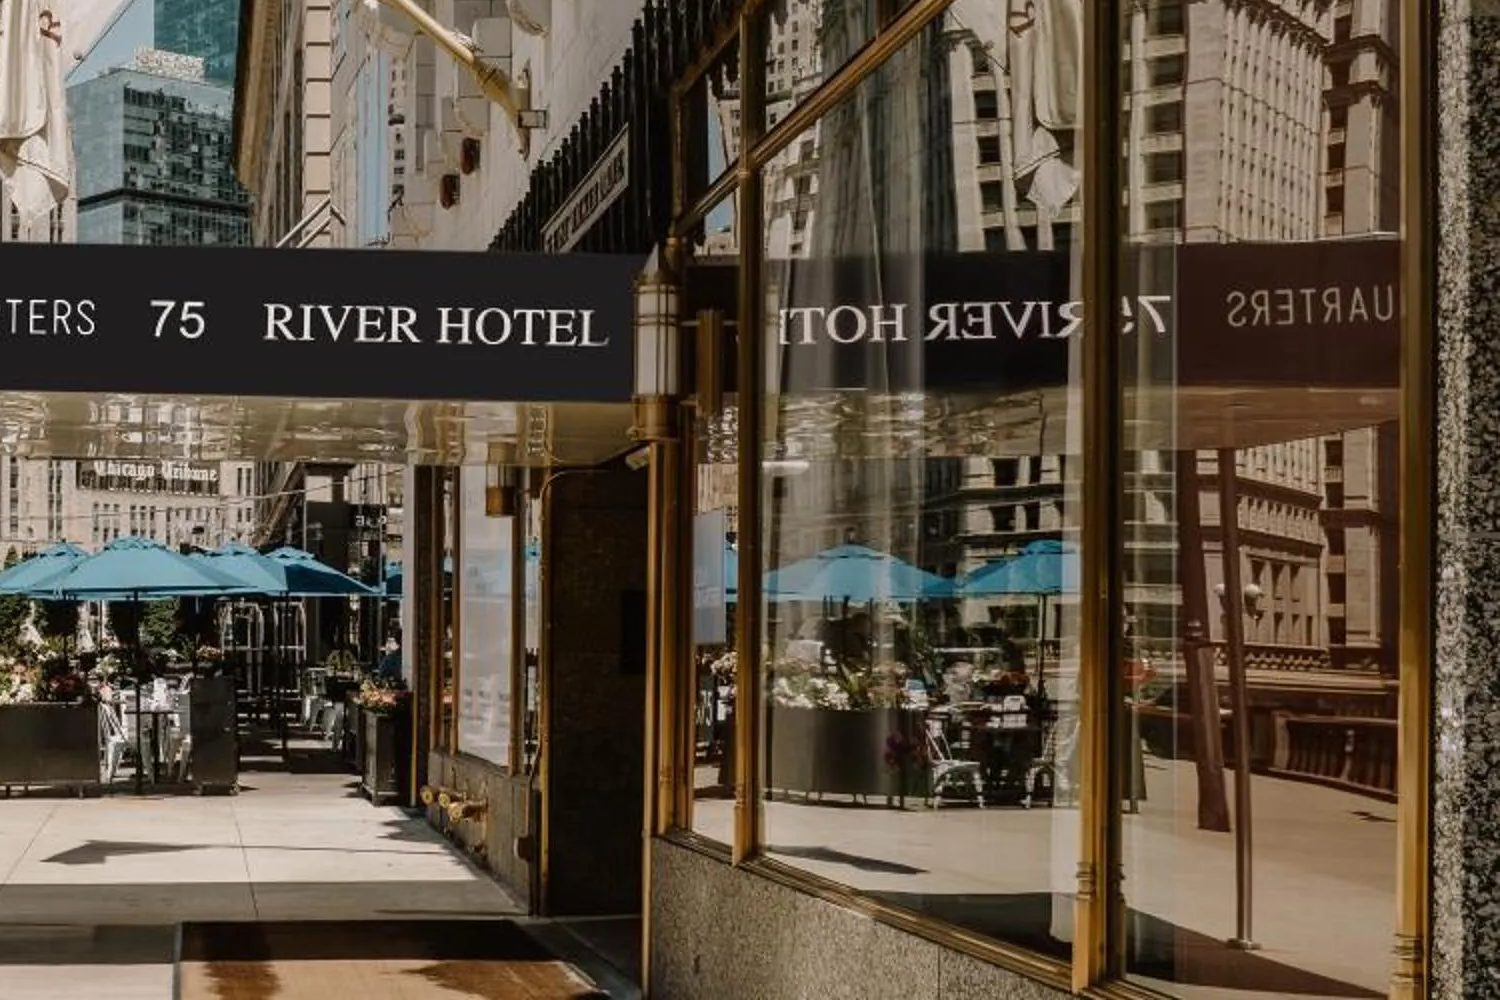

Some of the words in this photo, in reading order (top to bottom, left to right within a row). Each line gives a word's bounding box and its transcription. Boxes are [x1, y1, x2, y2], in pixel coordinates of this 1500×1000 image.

[151, 301, 205, 339] 75
[263, 302, 421, 343] RIVER
[436, 306, 610, 348] HOTEL
